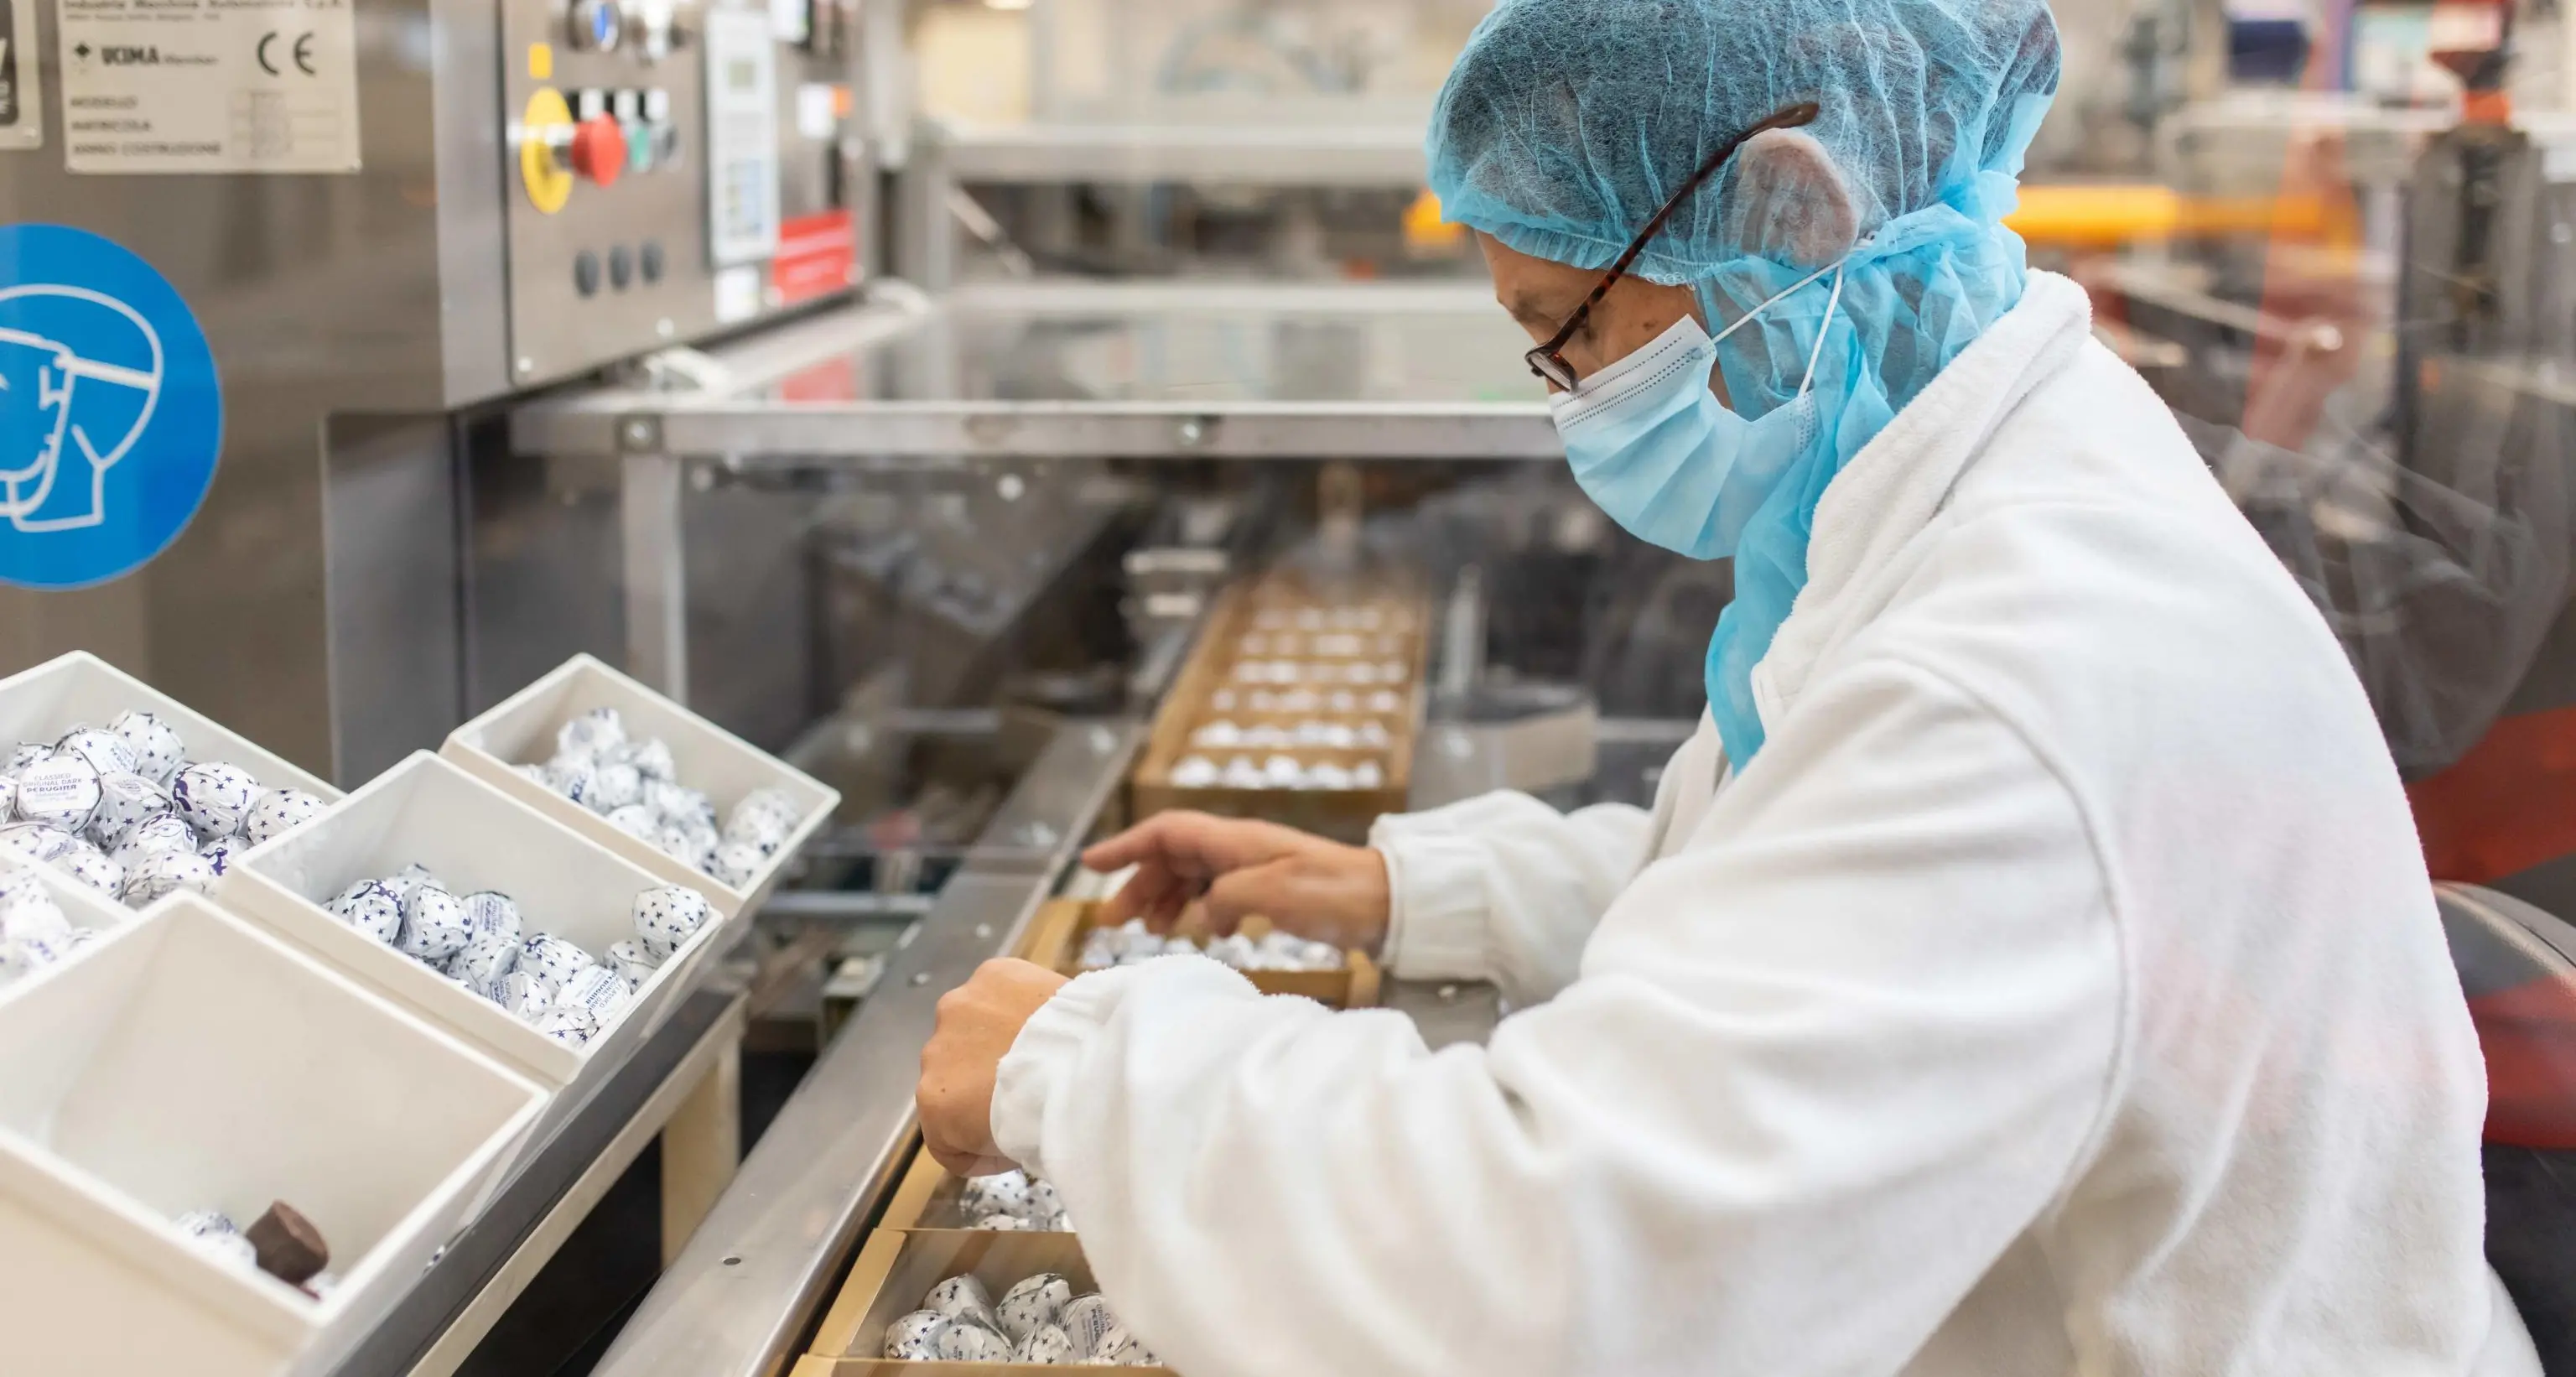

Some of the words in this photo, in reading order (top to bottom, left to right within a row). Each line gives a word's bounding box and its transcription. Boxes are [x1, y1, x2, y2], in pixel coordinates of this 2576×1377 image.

[256, 31, 318, 76] CE
[23, 780, 60, 788] ORIGINAL
[61, 777, 82, 786] DARK
[34, 772, 72, 781] CLASSICO
[1097, 1303, 1105, 1333] ORIGINA
